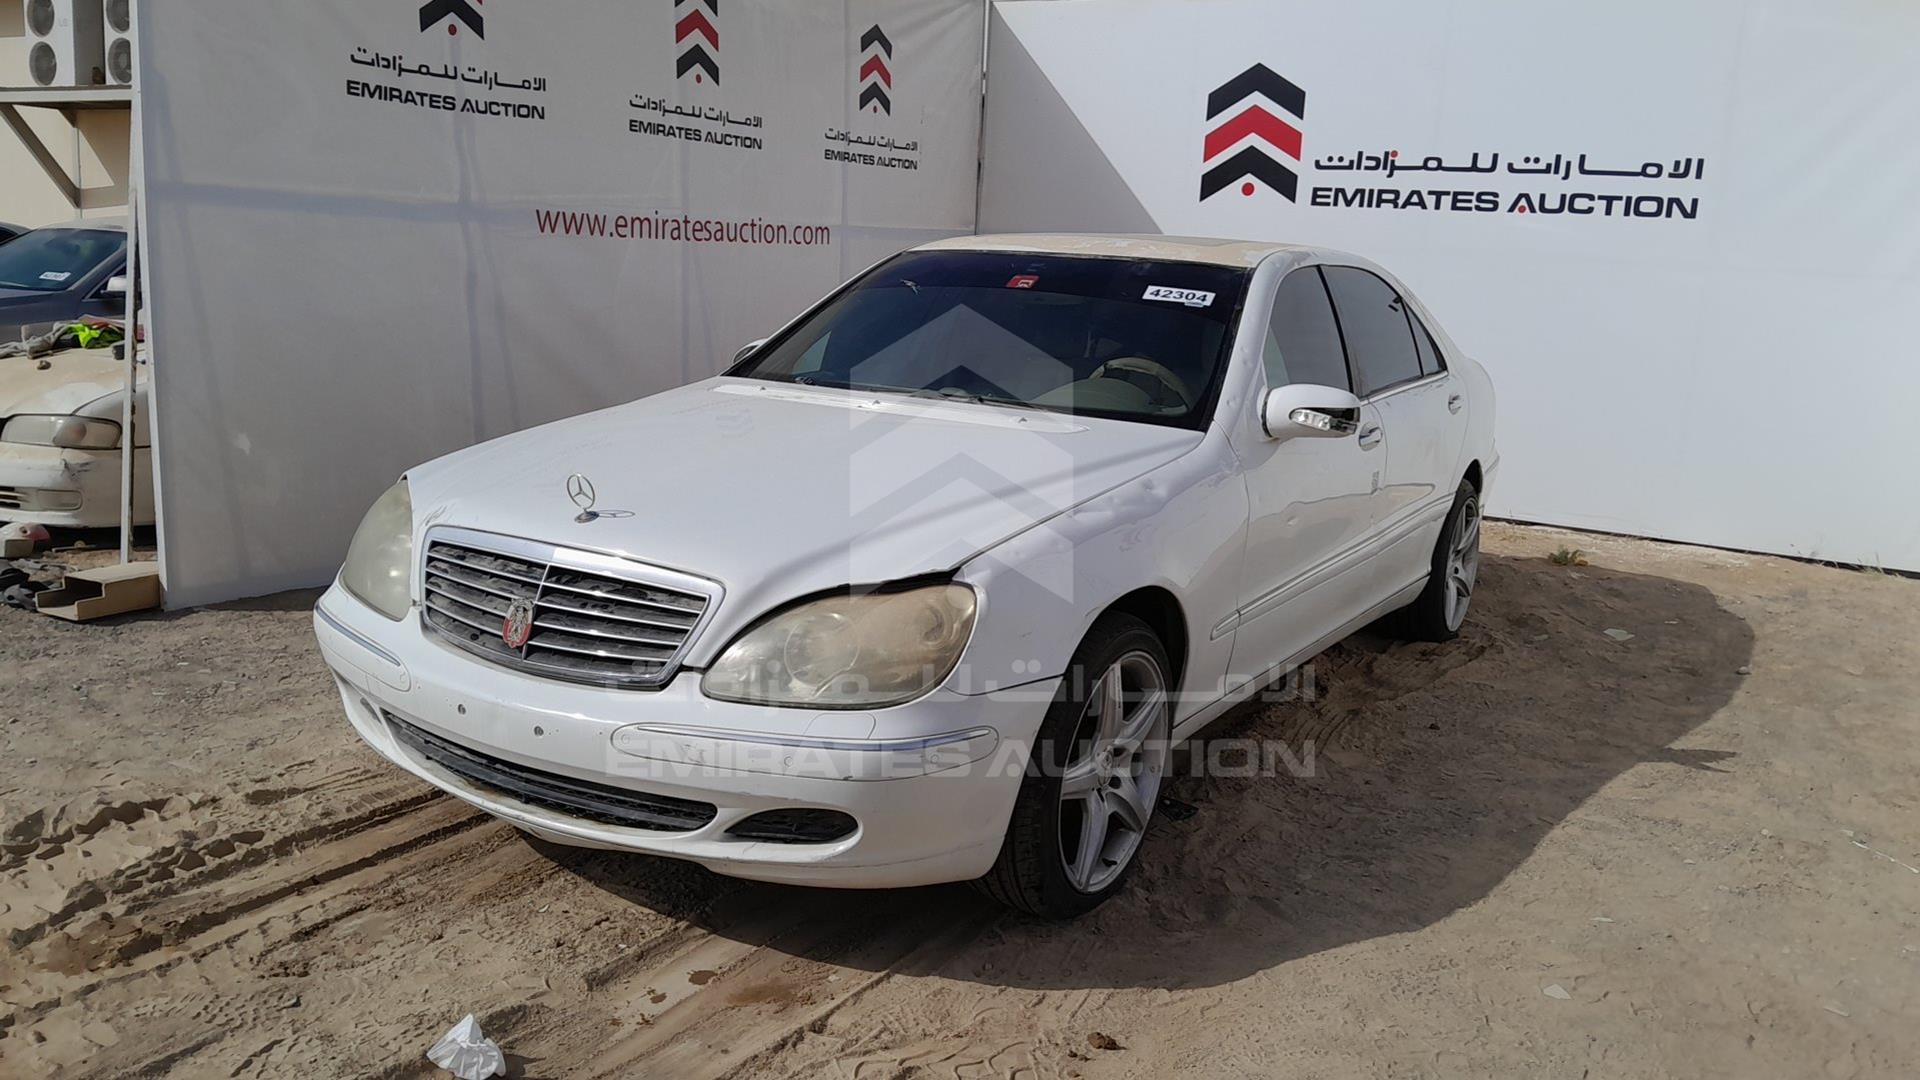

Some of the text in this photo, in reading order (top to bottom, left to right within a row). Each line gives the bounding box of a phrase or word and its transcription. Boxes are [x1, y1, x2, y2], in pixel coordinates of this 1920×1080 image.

[350, 47, 458, 79] للمزادات
[346, 80, 545, 120] EMIRATES AUCTION
[629, 94, 702, 117] للمزادات
[629, 119, 762, 150] EMIRATES AUCTION
[824, 149, 918, 170] EMIRATES AUCTION
[1314, 150, 1705, 181] الامارات للمزادات
[1310, 187, 1699, 219] EMIRATES AUCTION
[536, 209, 830, 245] www.emiratesauction.com
[1149, 289, 1208, 303] 42304
